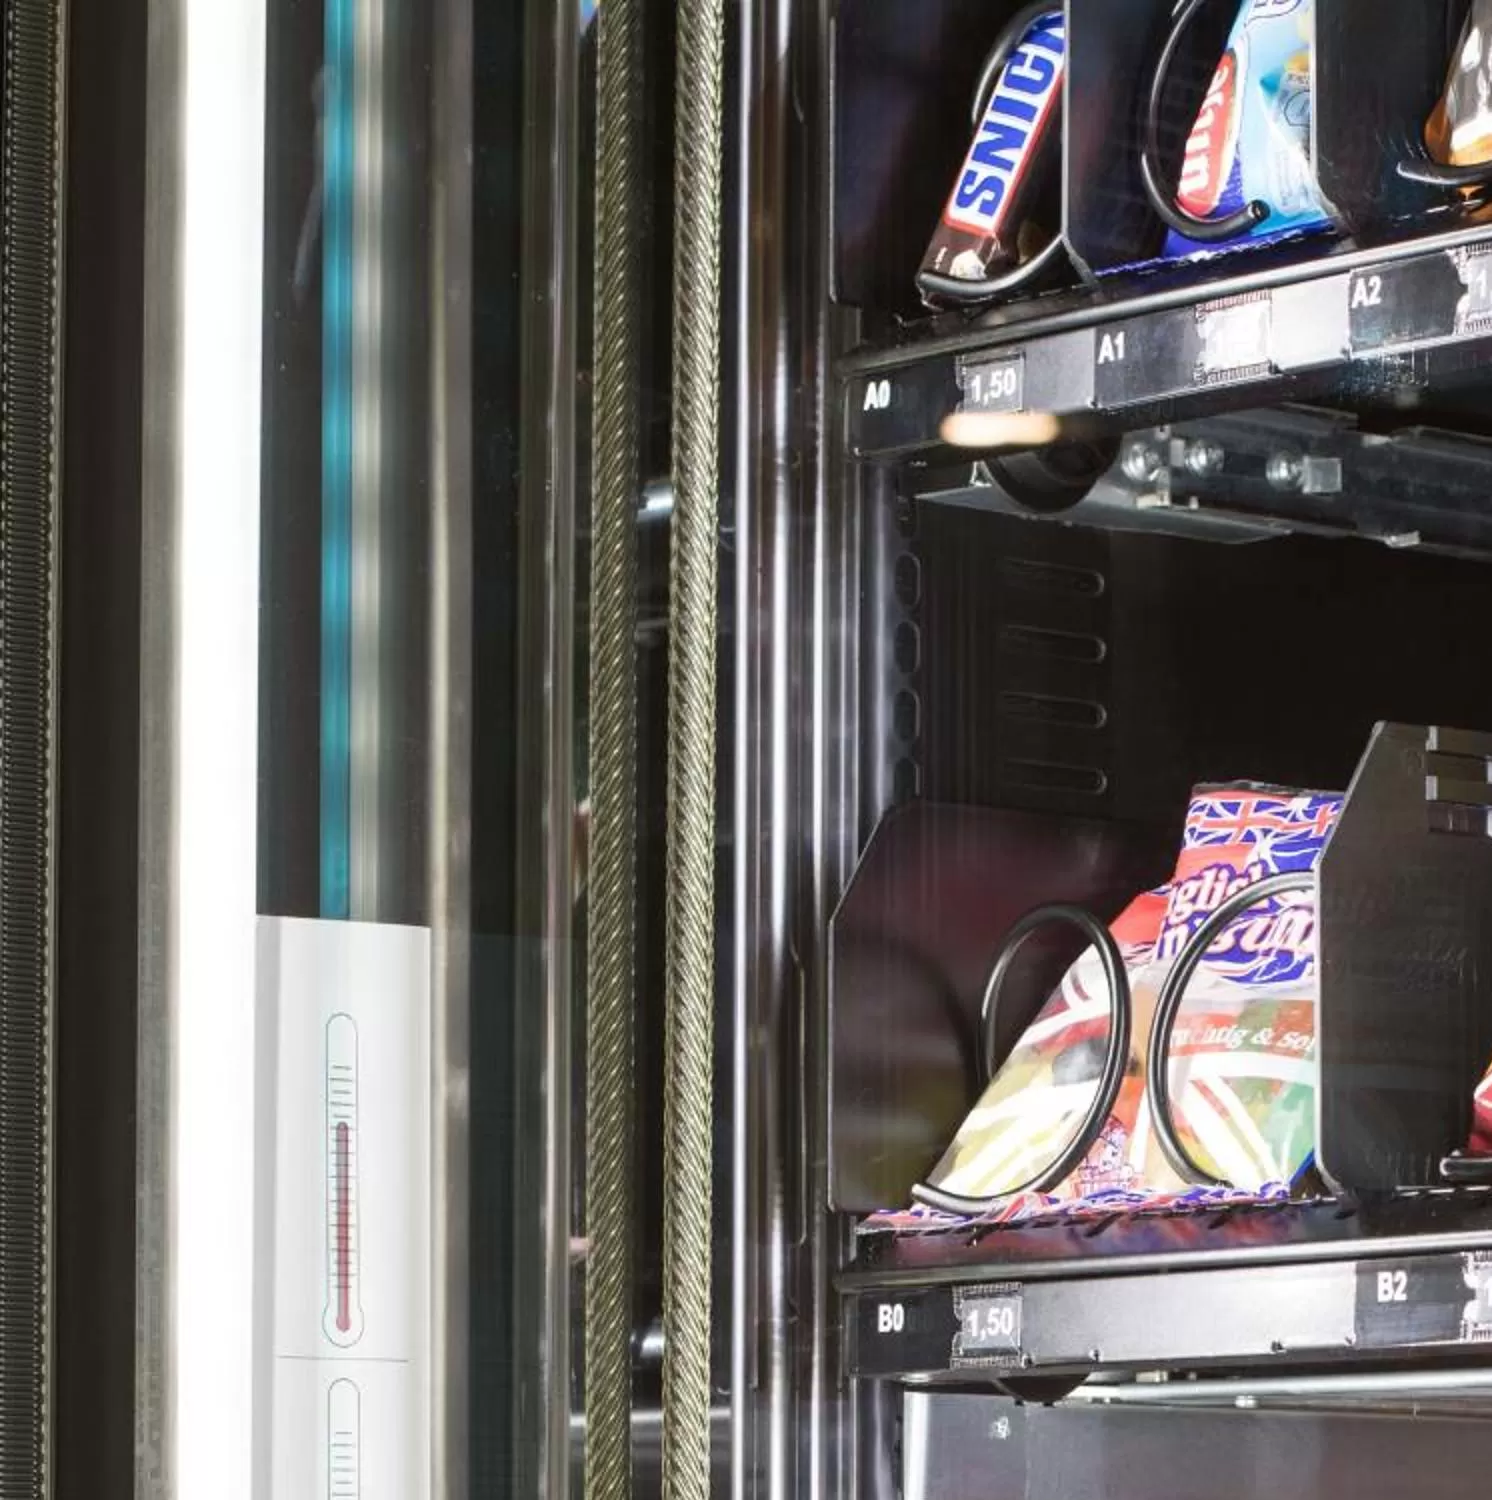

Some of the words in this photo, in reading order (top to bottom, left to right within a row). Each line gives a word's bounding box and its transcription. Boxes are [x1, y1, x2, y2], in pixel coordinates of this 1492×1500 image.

[1352, 276, 1381, 307] A2
[1099, 333, 1125, 364] A1
[863, 380, 890, 411] A0
[970, 368, 1017, 404] 1,50
[1378, 1271, 1407, 1302] B2
[878, 1304, 903, 1332] B0
[967, 1307, 1014, 1339] 1,50
